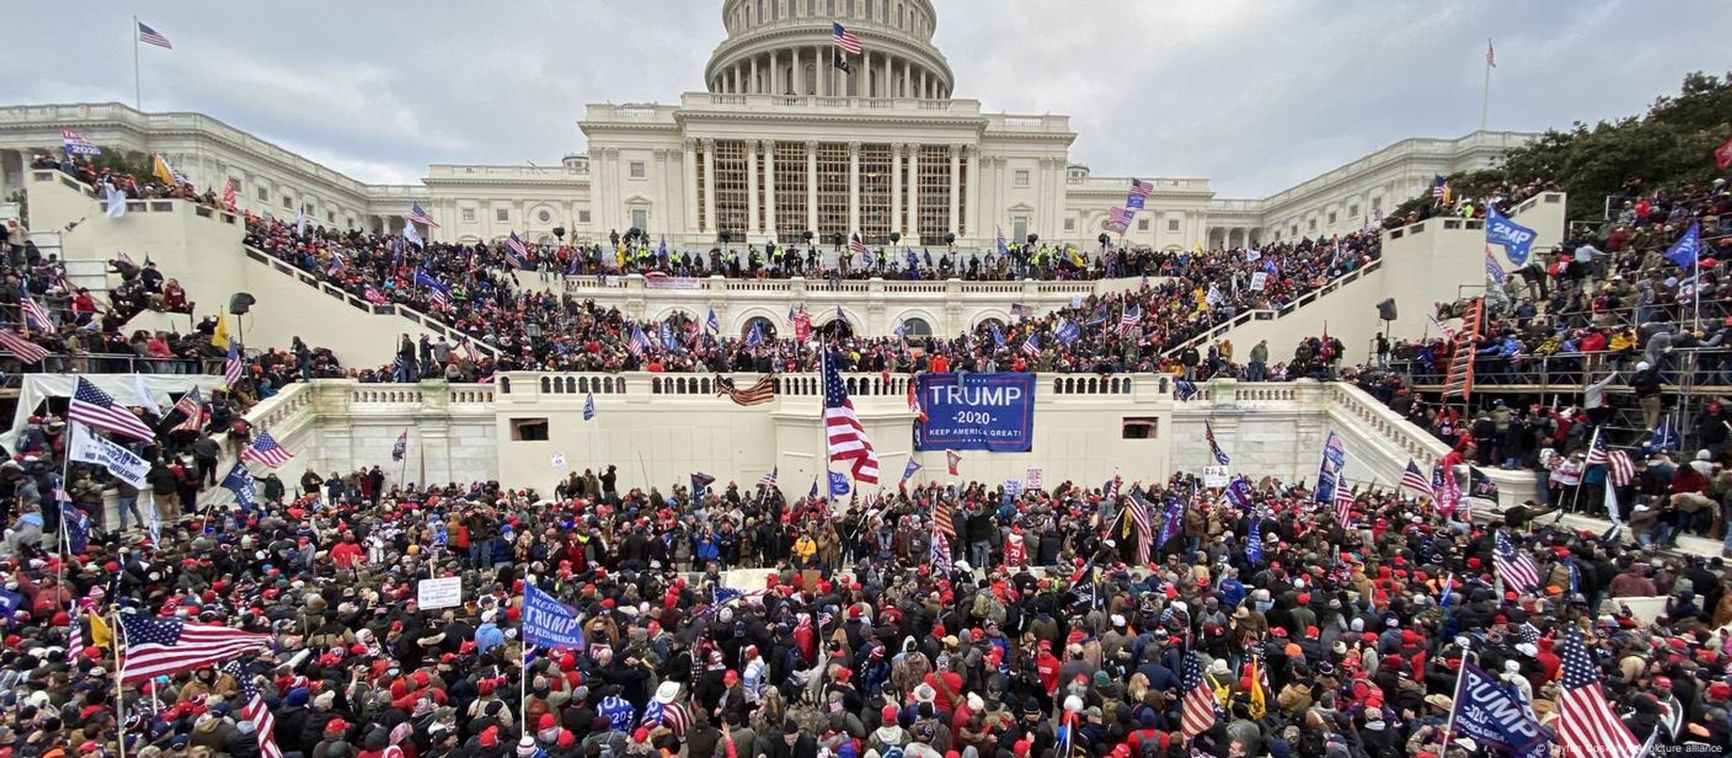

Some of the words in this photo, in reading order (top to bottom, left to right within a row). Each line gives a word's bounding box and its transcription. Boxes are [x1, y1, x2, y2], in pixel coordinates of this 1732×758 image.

[929, 385, 1021, 406] TRUMP
[990, 428, 1021, 437] GREAT!
[85, 452, 96, 460] NO
[527, 605, 576, 635] TRUMP
